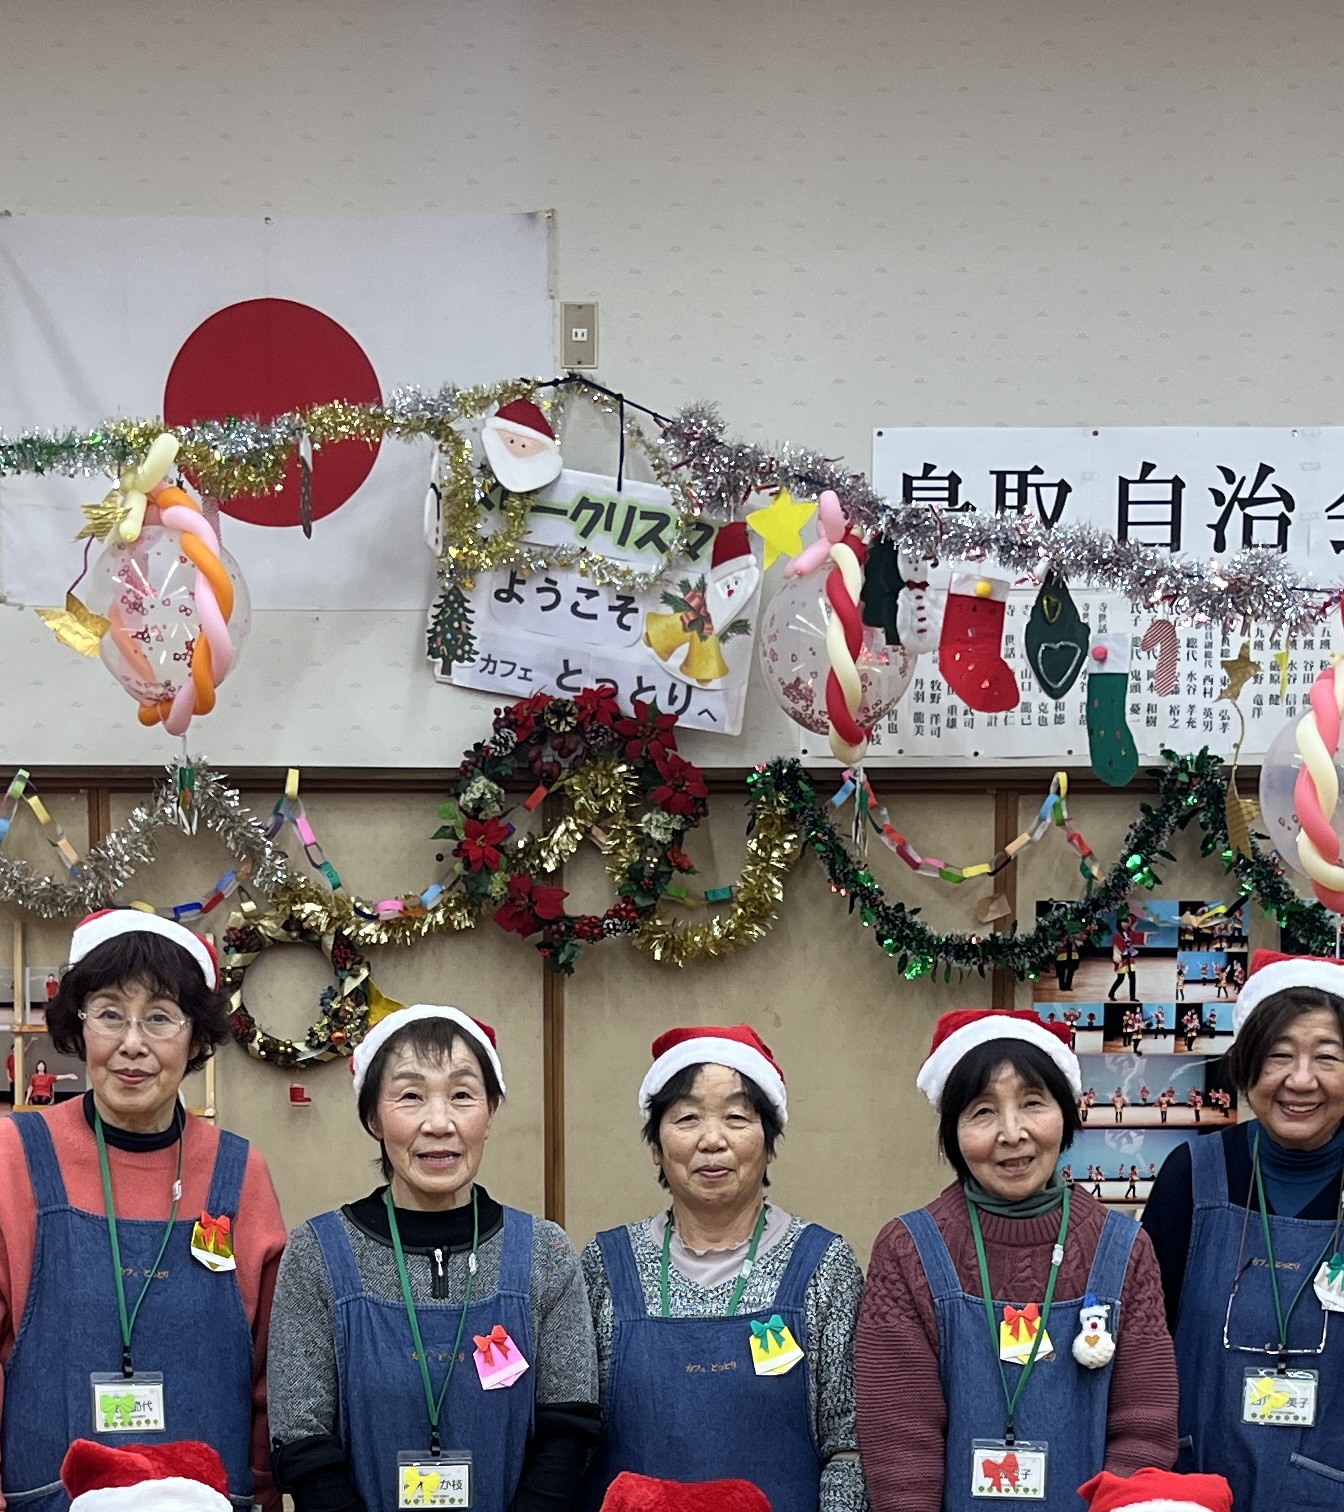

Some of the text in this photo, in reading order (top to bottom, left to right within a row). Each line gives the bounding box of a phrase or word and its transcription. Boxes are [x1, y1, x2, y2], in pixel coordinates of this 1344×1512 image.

[493, 569, 639, 632] ようこそ
[479, 653, 533, 682] カフェ
[1020, 667, 1032, 692] 山口
[913, 678, 925, 703] 丹羽
[929, 679, 941, 704] 牧野
[1185, 670, 1197, 695] 水谷
